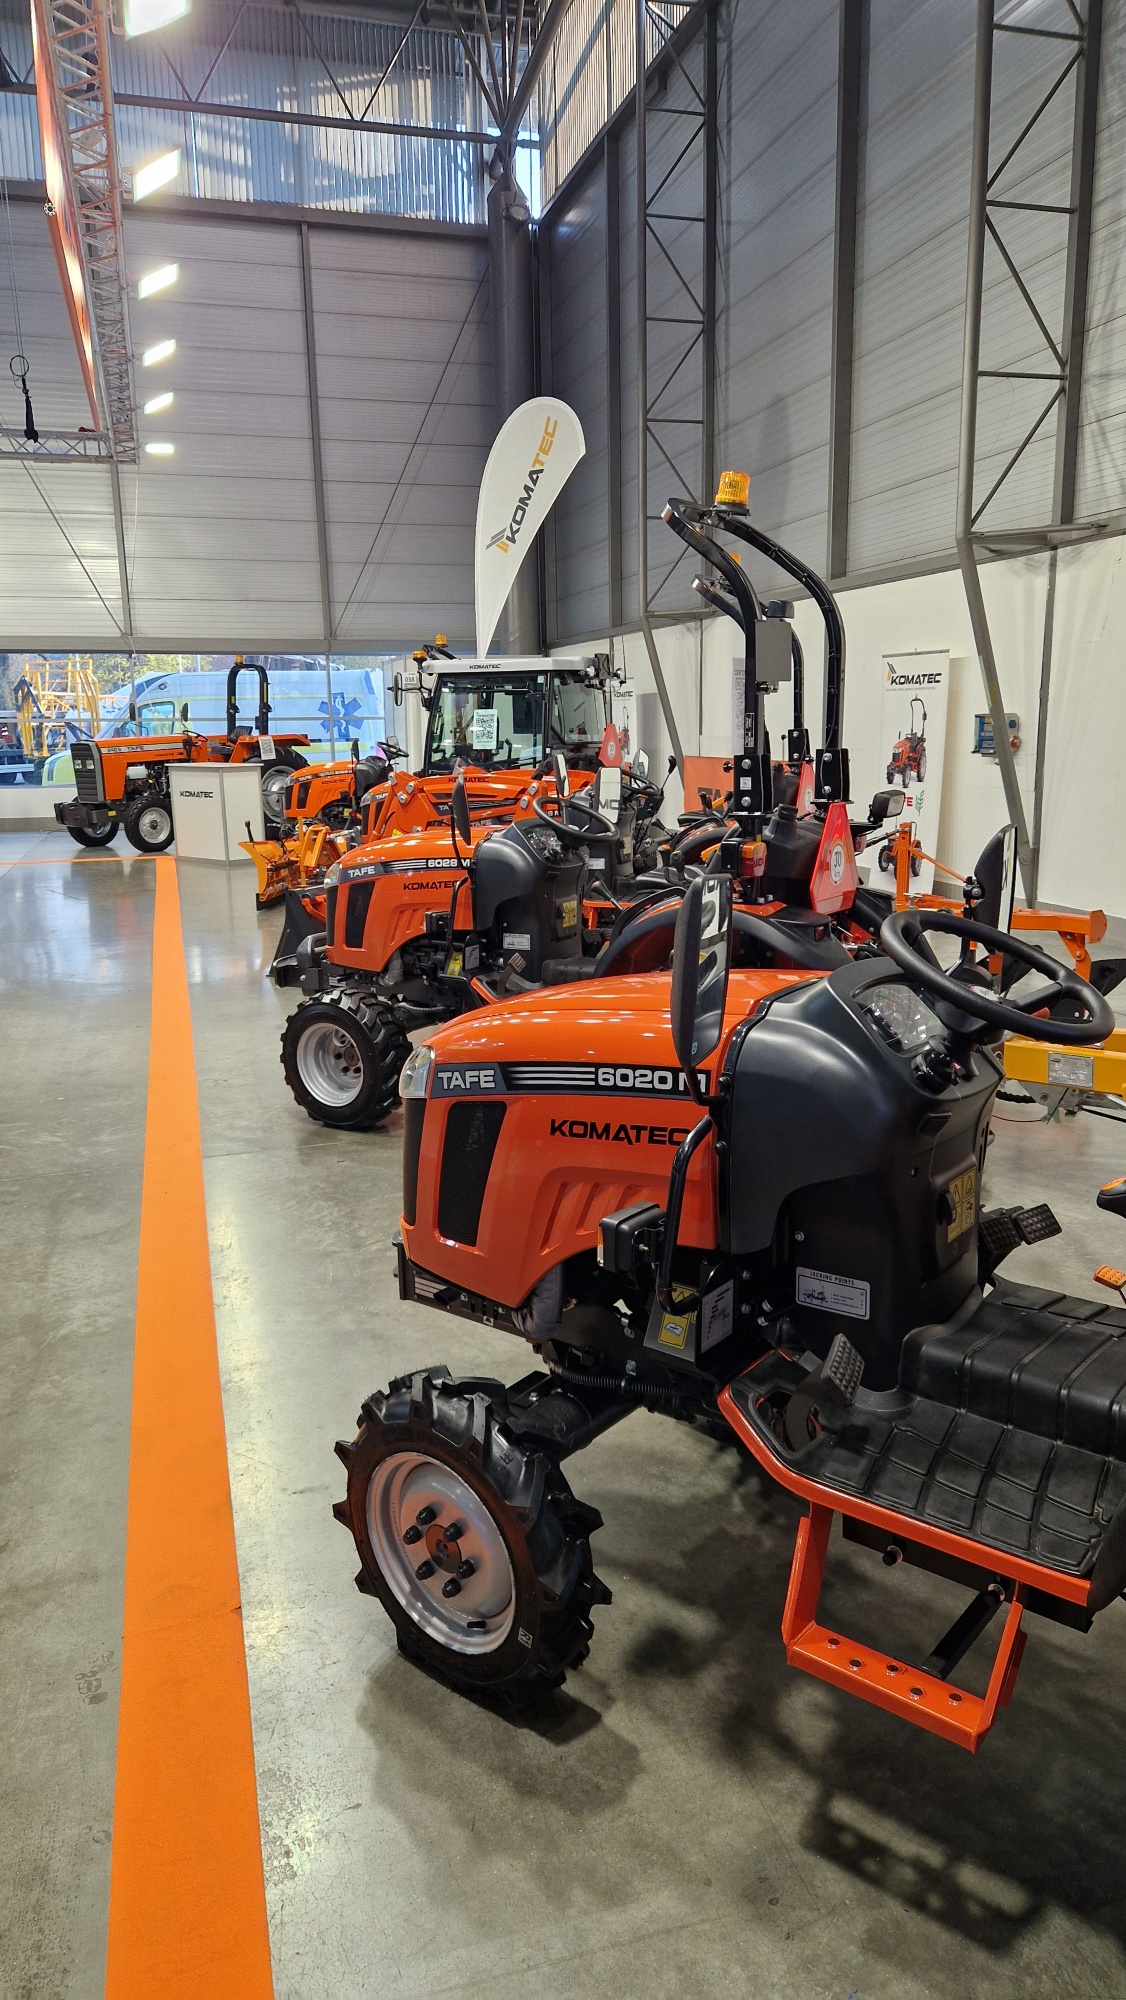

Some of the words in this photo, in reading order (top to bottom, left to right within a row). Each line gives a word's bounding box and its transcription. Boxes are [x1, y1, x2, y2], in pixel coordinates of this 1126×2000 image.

[505, 415, 558, 545] KOMATEC
[890, 672, 942, 686] KOMATEC
[180, 790, 213, 798] KOMATEC
[347, 865, 376, 878] TAFE
[427, 858, 458, 868] 6028
[437, 1069, 496, 1090] TAFE
[597, 1067, 673, 1090] 6020
[550, 1118, 691, 1146] KOMATEC
[810, 1270, 833, 1281] JACKING
[834, 1276, 855, 1286] POINTS
